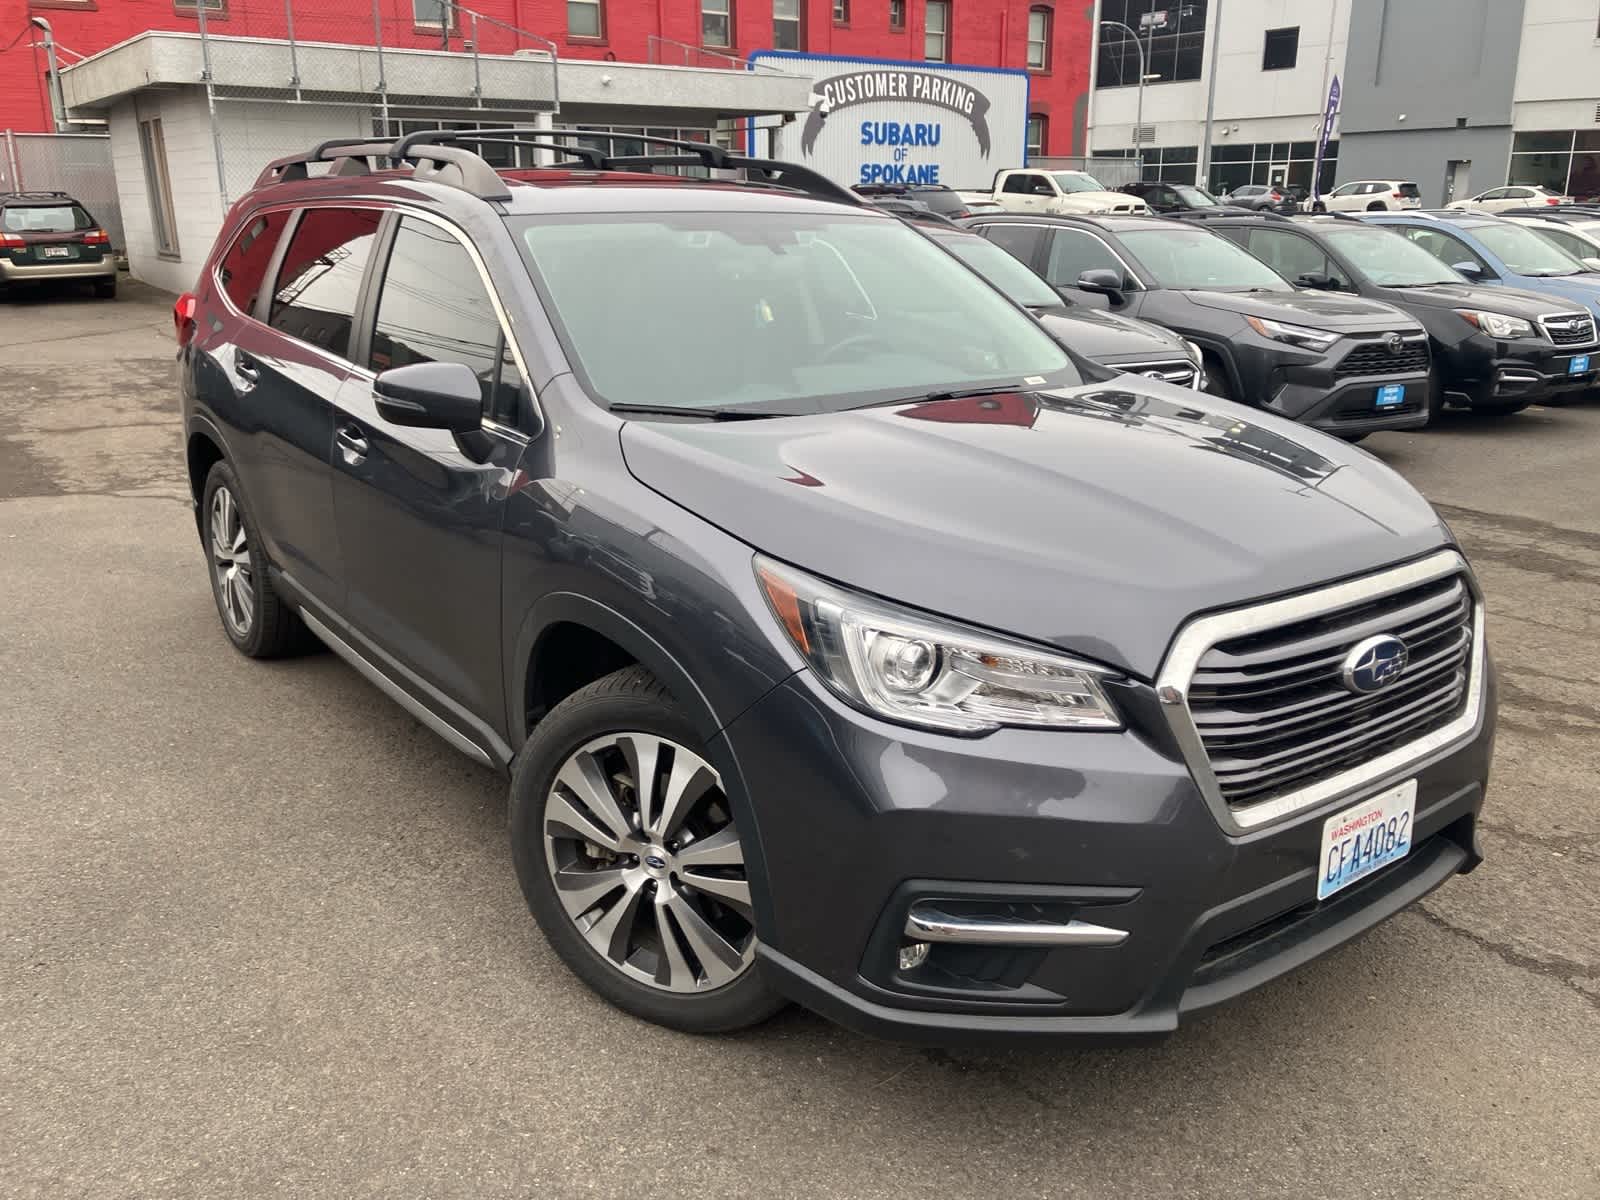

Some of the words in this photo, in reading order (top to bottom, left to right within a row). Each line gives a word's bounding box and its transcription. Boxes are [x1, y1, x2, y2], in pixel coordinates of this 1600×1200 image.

[824, 74, 908, 109] CUSTOMER
[913, 75, 976, 114] PARKING
[861, 122, 941, 146] SUBARU
[893, 148, 908, 162] OF
[860, 164, 939, 184] SPOKANE
[1331, 808, 1383, 840] WASHINGTON
[1326, 811, 1410, 883] CFA4082
